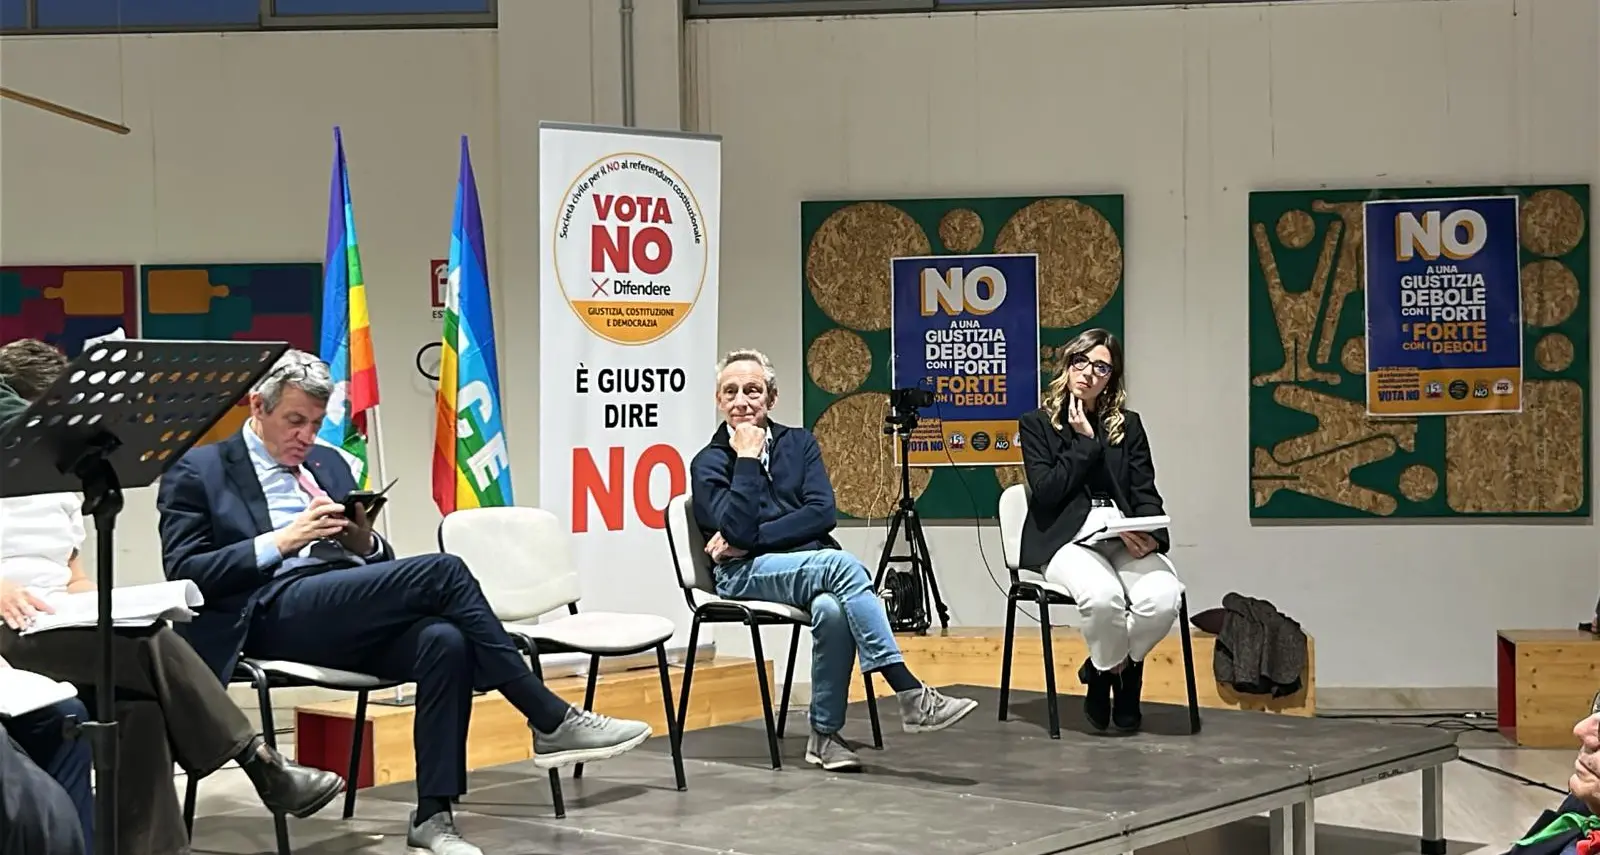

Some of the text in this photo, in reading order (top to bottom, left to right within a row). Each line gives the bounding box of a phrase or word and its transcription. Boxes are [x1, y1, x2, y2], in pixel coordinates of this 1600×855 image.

[560, 160, 701, 244] Società civile per il NO al referendum costituzionale
[592, 194, 673, 224] VOTA
[1395, 209, 1488, 262] NO
[591, 225, 673, 275] NO
[1427, 265, 1458, 274] A UNA
[614, 280, 671, 296] Difendere
[1401, 274, 1485, 289] GIUSTIZIA
[920, 266, 1007, 317] NO
[1401, 288, 1486, 307] DEBOLE
[588, 307, 674, 316] GIUSTIZIA, COSTITUZIONE
[1402, 307, 1424, 316] CON
[1431, 306, 1486, 321] FORTI
[607, 319, 658, 327] E DEMOCRAZIA
[959, 320, 980, 328] UNA
[1413, 322, 1487, 340] FORTE
[925, 329, 1005, 343] GIUSTIZIA
[926, 342, 1006, 360] DEBOLE
[1402, 341, 1424, 350] CON
[1432, 340, 1487, 354] DEBOLI
[926, 361, 947, 369] CON
[954, 360, 1006, 375] FORTI
[576, 362, 686, 393] È GIUSTO
[936, 375, 1007, 393] FORTE
[933, 394, 948, 403] ON
[955, 393, 1007, 406] DEBOLI
[605, 403, 658, 428] DIRE
[572, 443, 687, 533] NO
